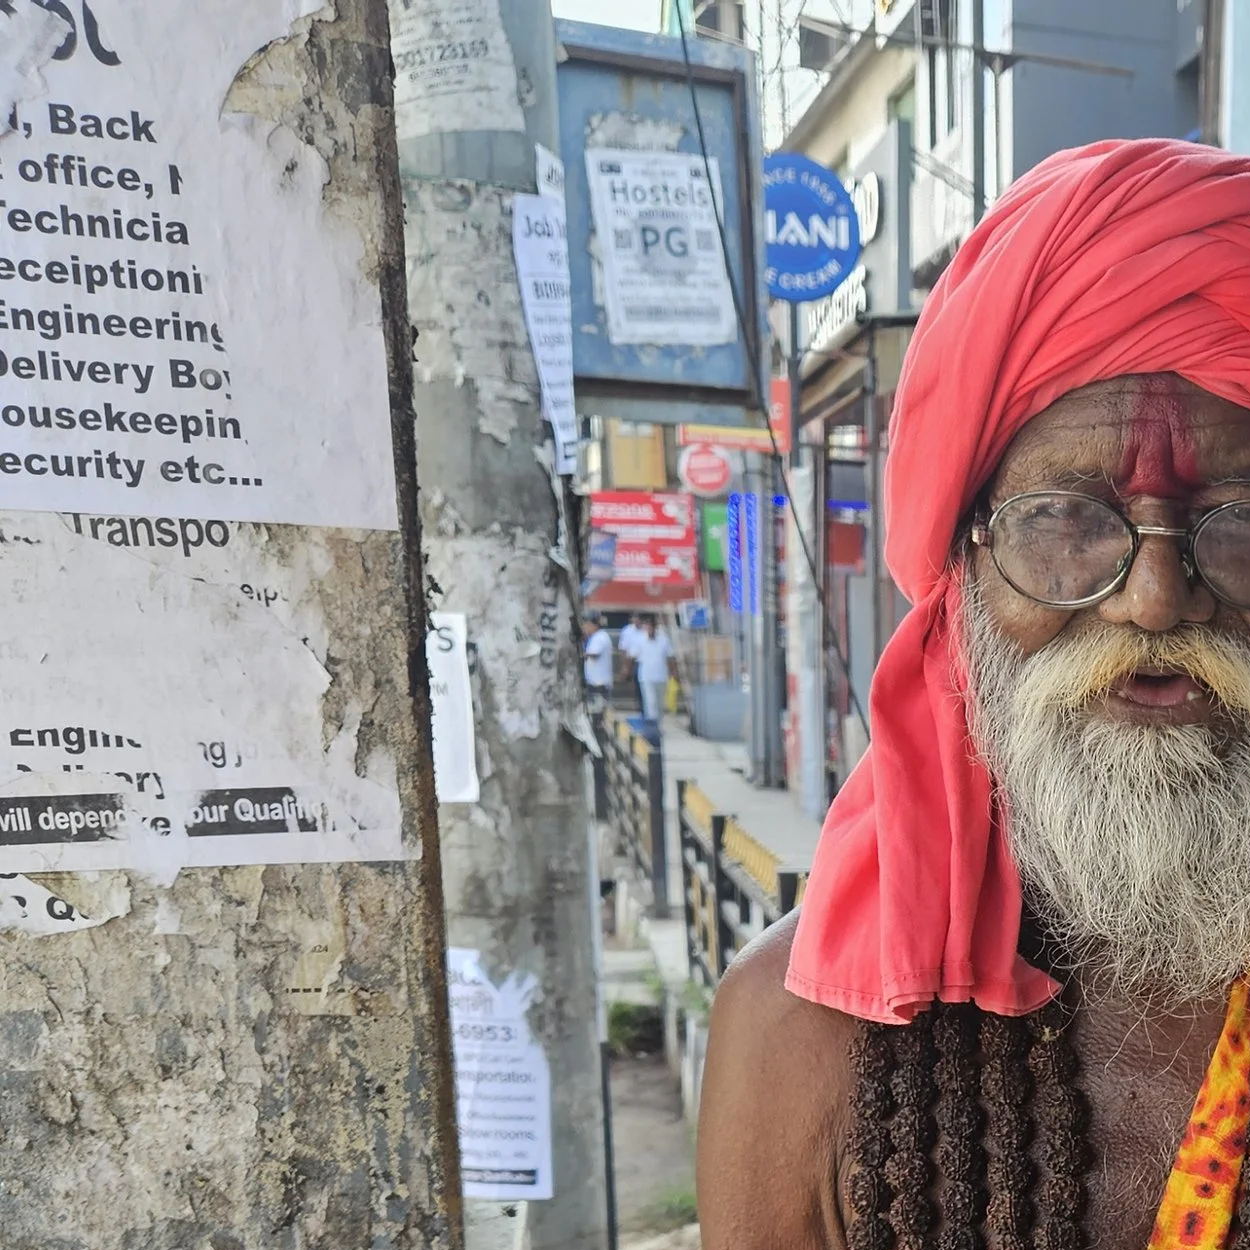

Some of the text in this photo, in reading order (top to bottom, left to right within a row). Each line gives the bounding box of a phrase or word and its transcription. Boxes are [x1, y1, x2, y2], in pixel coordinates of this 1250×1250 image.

[48, 103, 158, 144] Back
[18, 153, 154, 200] office,
[0, 200, 190, 246] echnicia
[641, 226, 690, 258] PG
[1, 402, 249, 444] ousekeepin
[0, 449, 263, 488] ecurity etc...
